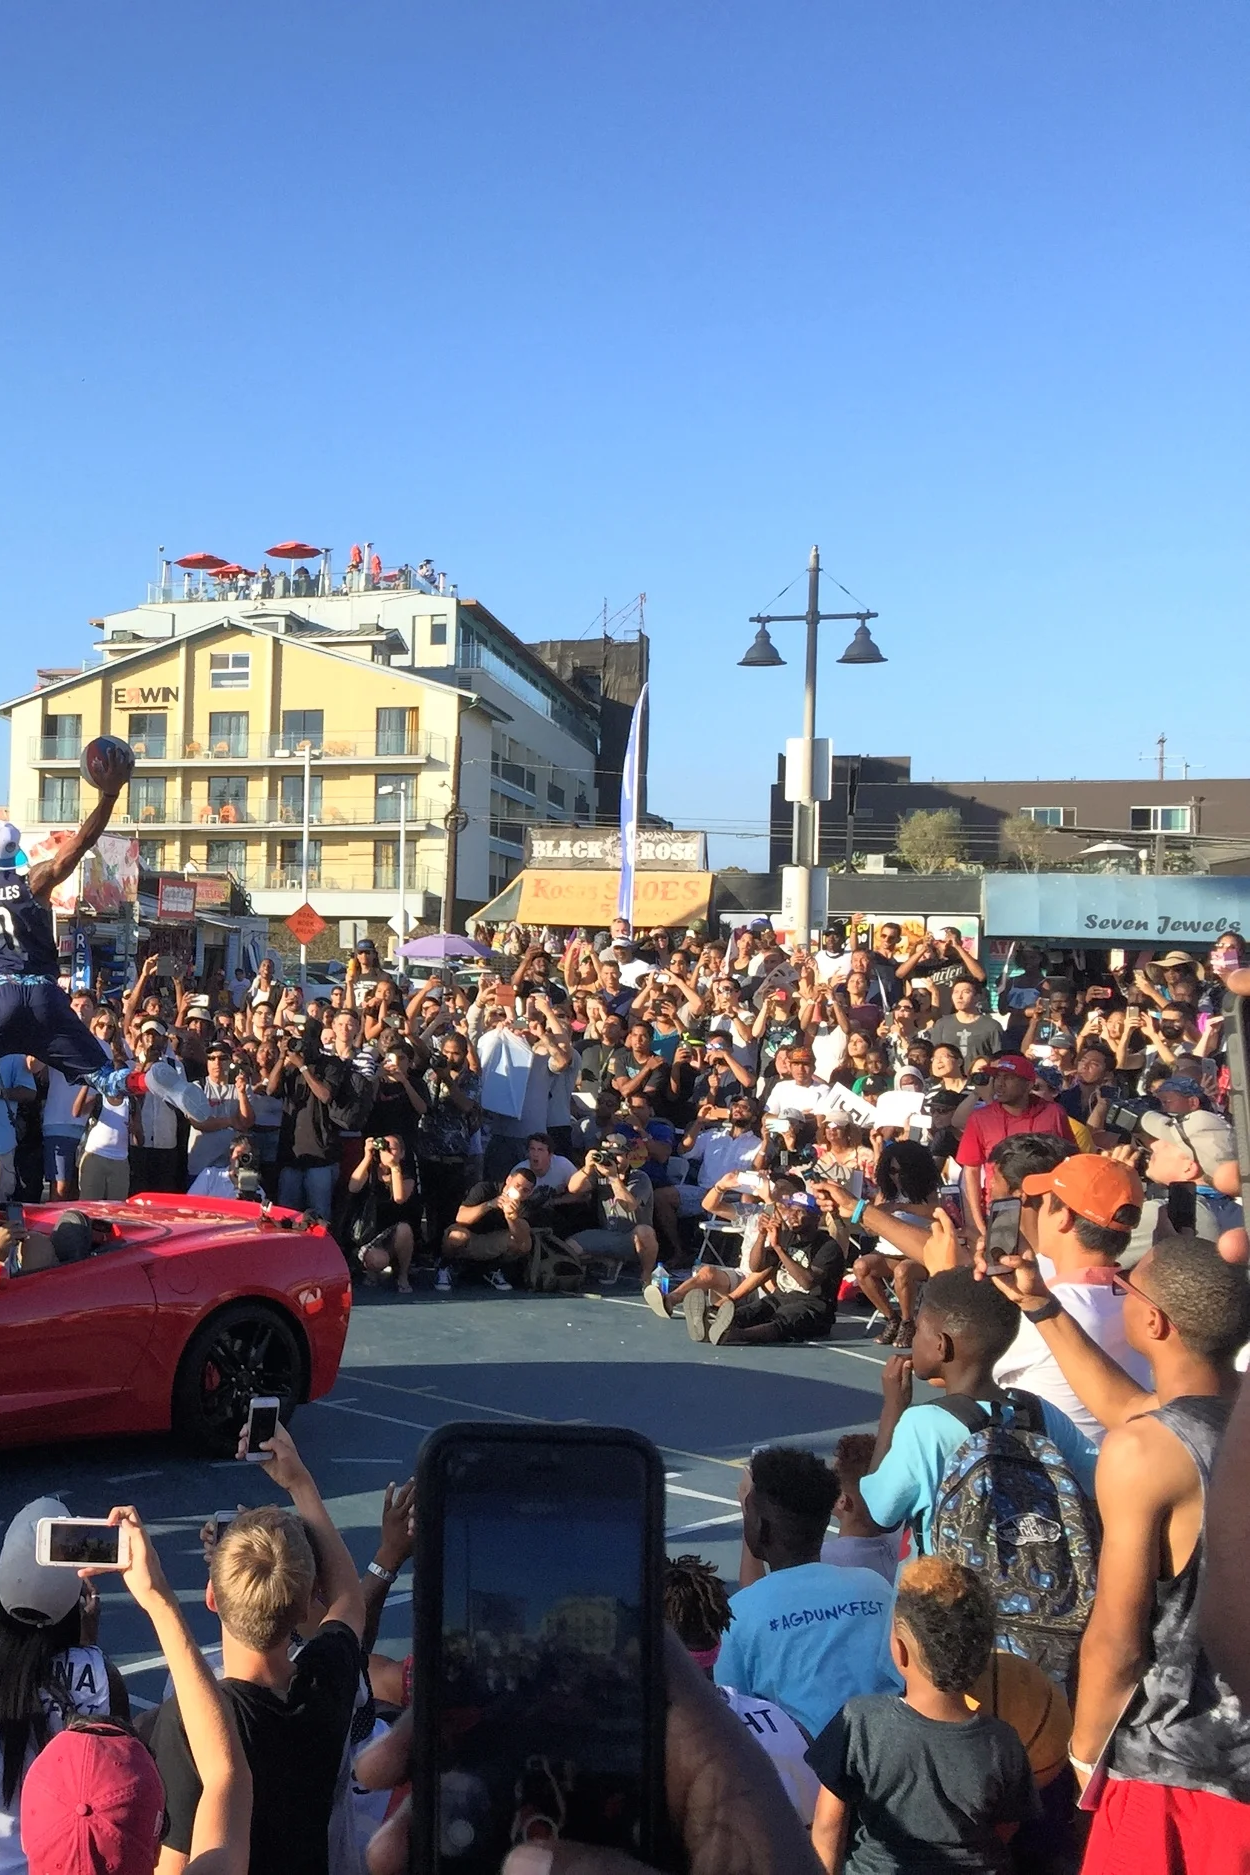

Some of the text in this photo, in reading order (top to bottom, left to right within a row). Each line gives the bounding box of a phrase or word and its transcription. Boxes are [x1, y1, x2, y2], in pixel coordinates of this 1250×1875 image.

[531, 840, 698, 861] BLACK ROSE
[1085, 914, 1242, 935] Seven Jewels
[769, 1600, 884, 1632] #AGDUNKFEST
